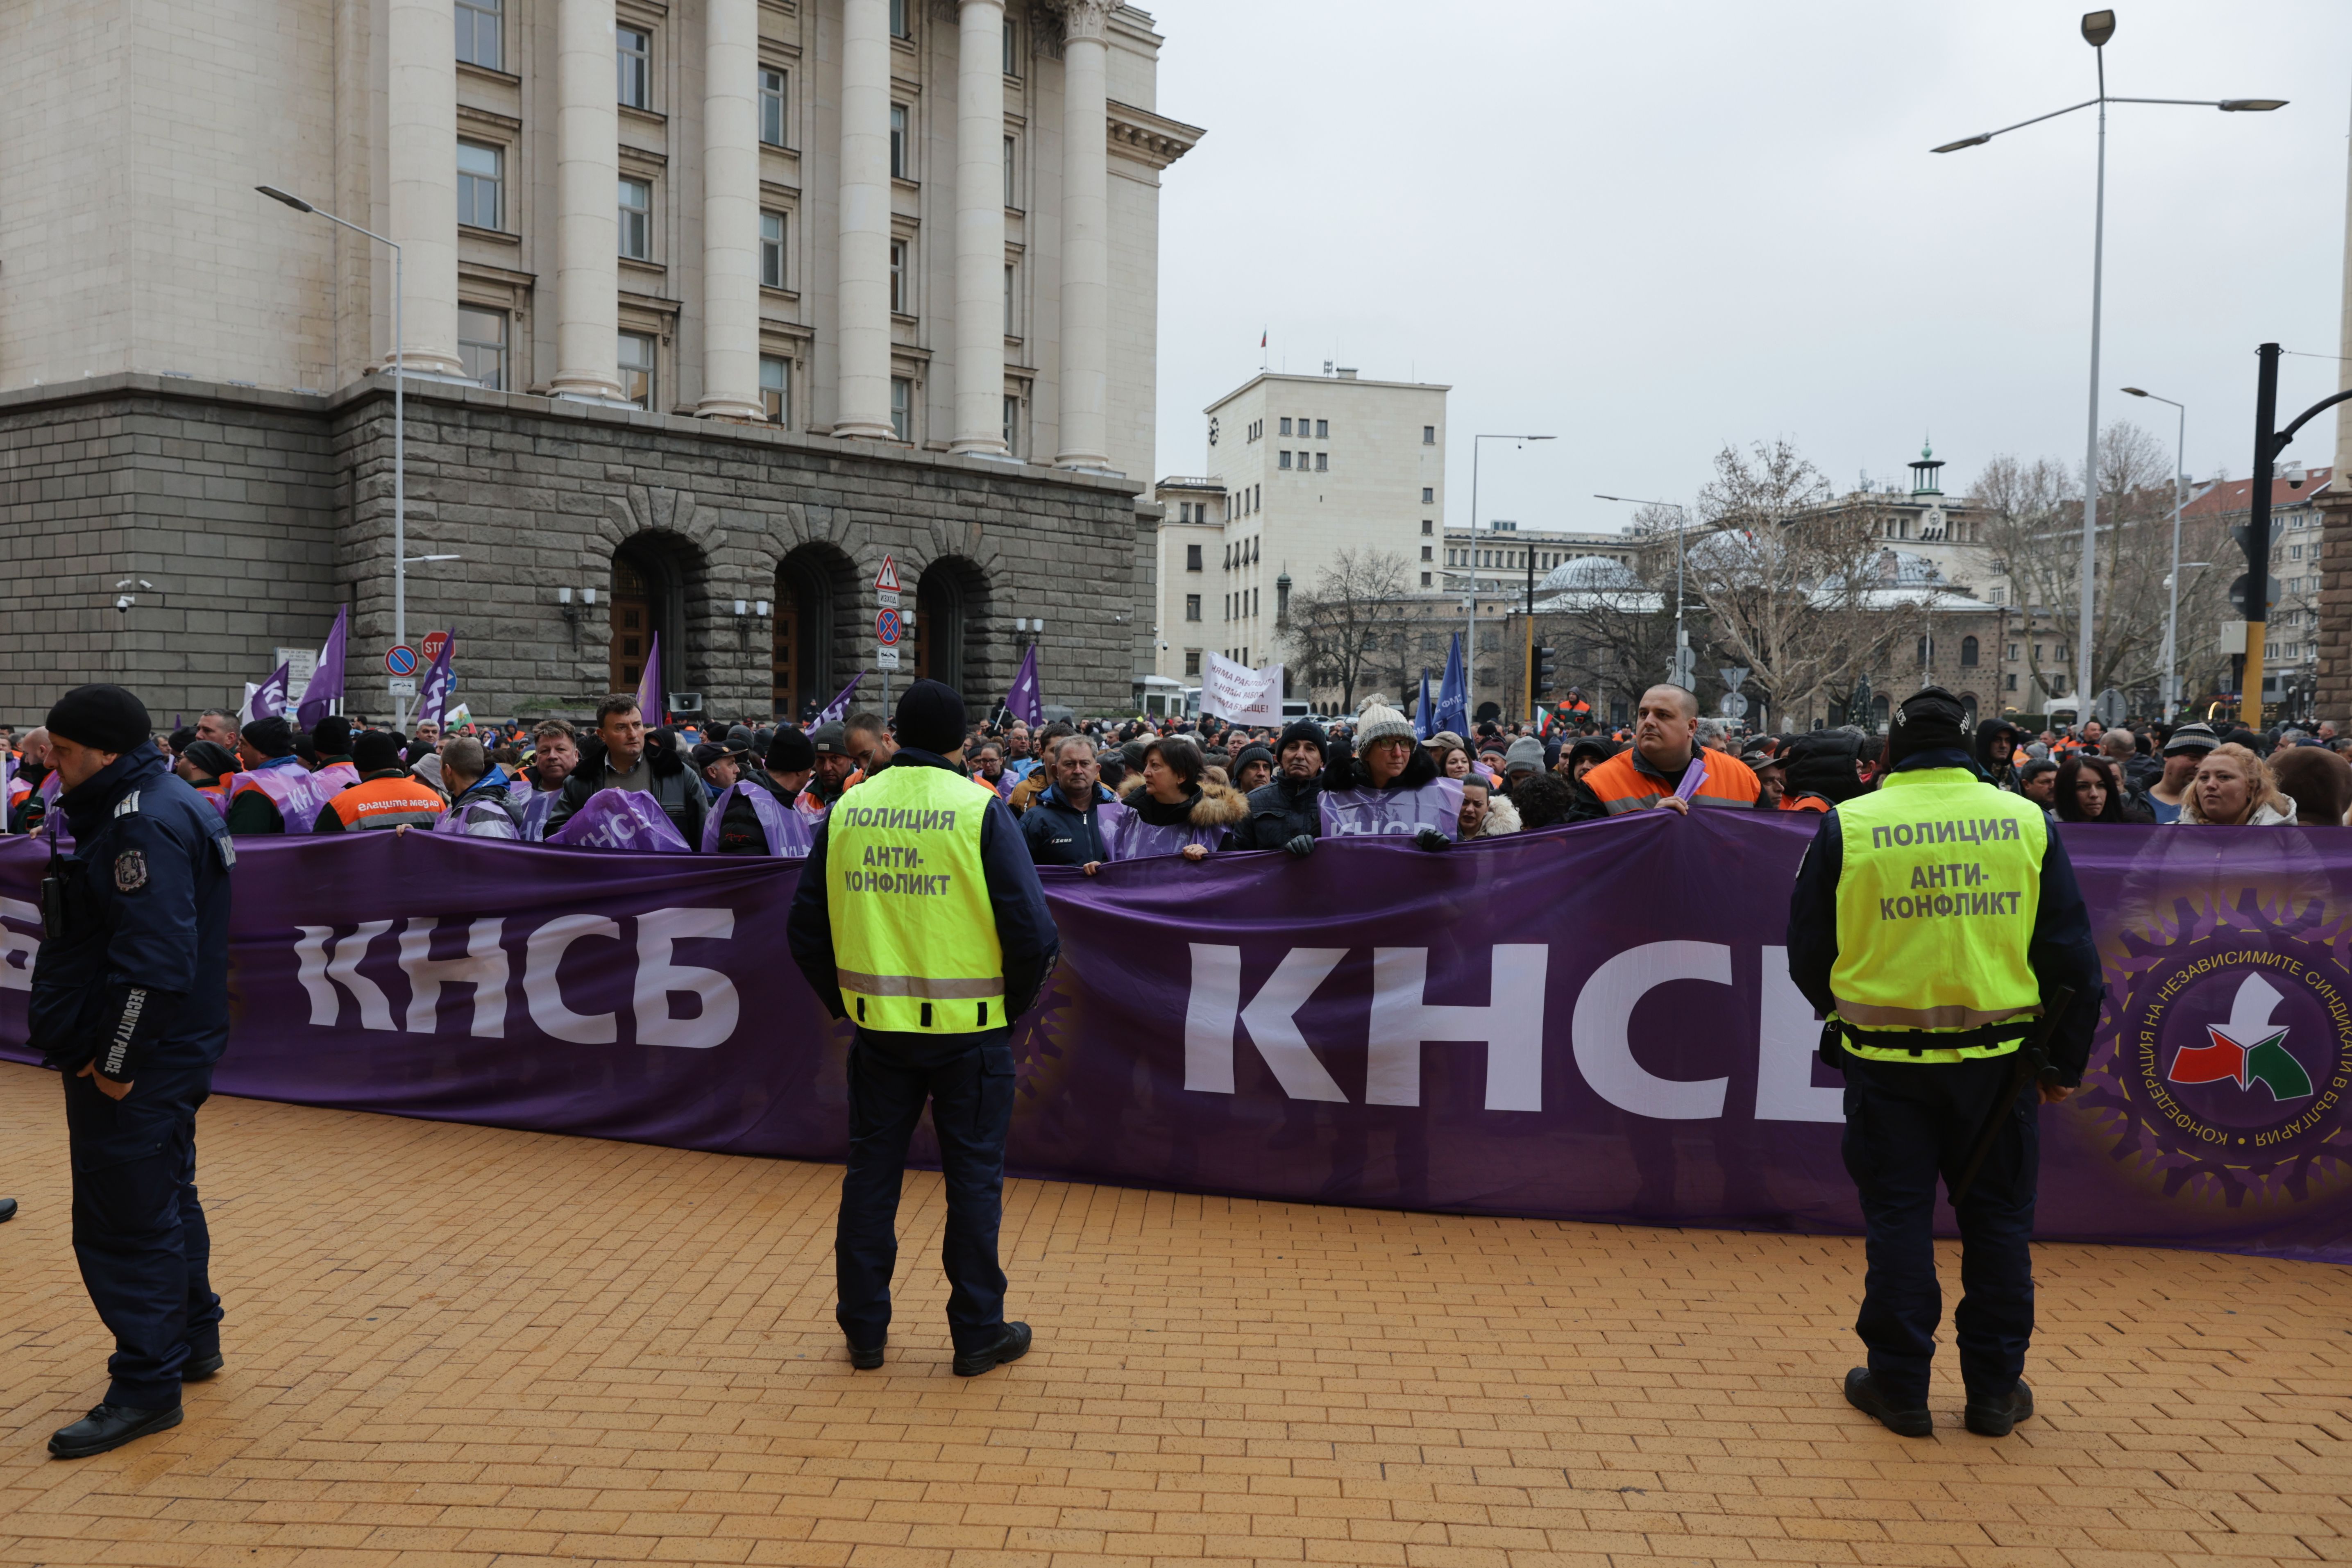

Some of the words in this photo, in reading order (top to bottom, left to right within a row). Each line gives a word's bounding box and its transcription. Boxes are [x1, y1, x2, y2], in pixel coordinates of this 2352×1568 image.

[880, 594, 896, 604] ИЗХОД
[425, 642, 444, 654] STO
[1211, 664, 1233, 681] НЯМА
[1218, 683, 1241, 697] НЯМА
[844, 807, 955, 833] ПОЛИЦИЯ
[1872, 818, 2020, 849] ПОЛИЦИЯ
[863, 845, 924, 868] АНТИ-
[845, 871, 950, 895] КОНФЛИКТ
[1910, 862, 1989, 889] АНТИ-
[1880, 892, 2021, 920] КОНФЛИКТ
[293, 908, 740, 1049] КНСБ
[2157, 950, 2304, 1003] НЕЗАВИСИМИТЕ
[117, 988, 147, 1040] SECURITY
[2143, 1001, 2165, 1028] НА
[2305, 970, 2352, 1073] СИНДИКАТИ
[104, 1038, 128, 1074] POLICE
[2139, 1031, 2227, 1146] КОНФЕДЕРАЦИЯ
[2332, 1076, 2347, 1089] В
[2255, 1090, 2339, 1147] БЪЛГАРИЯ
